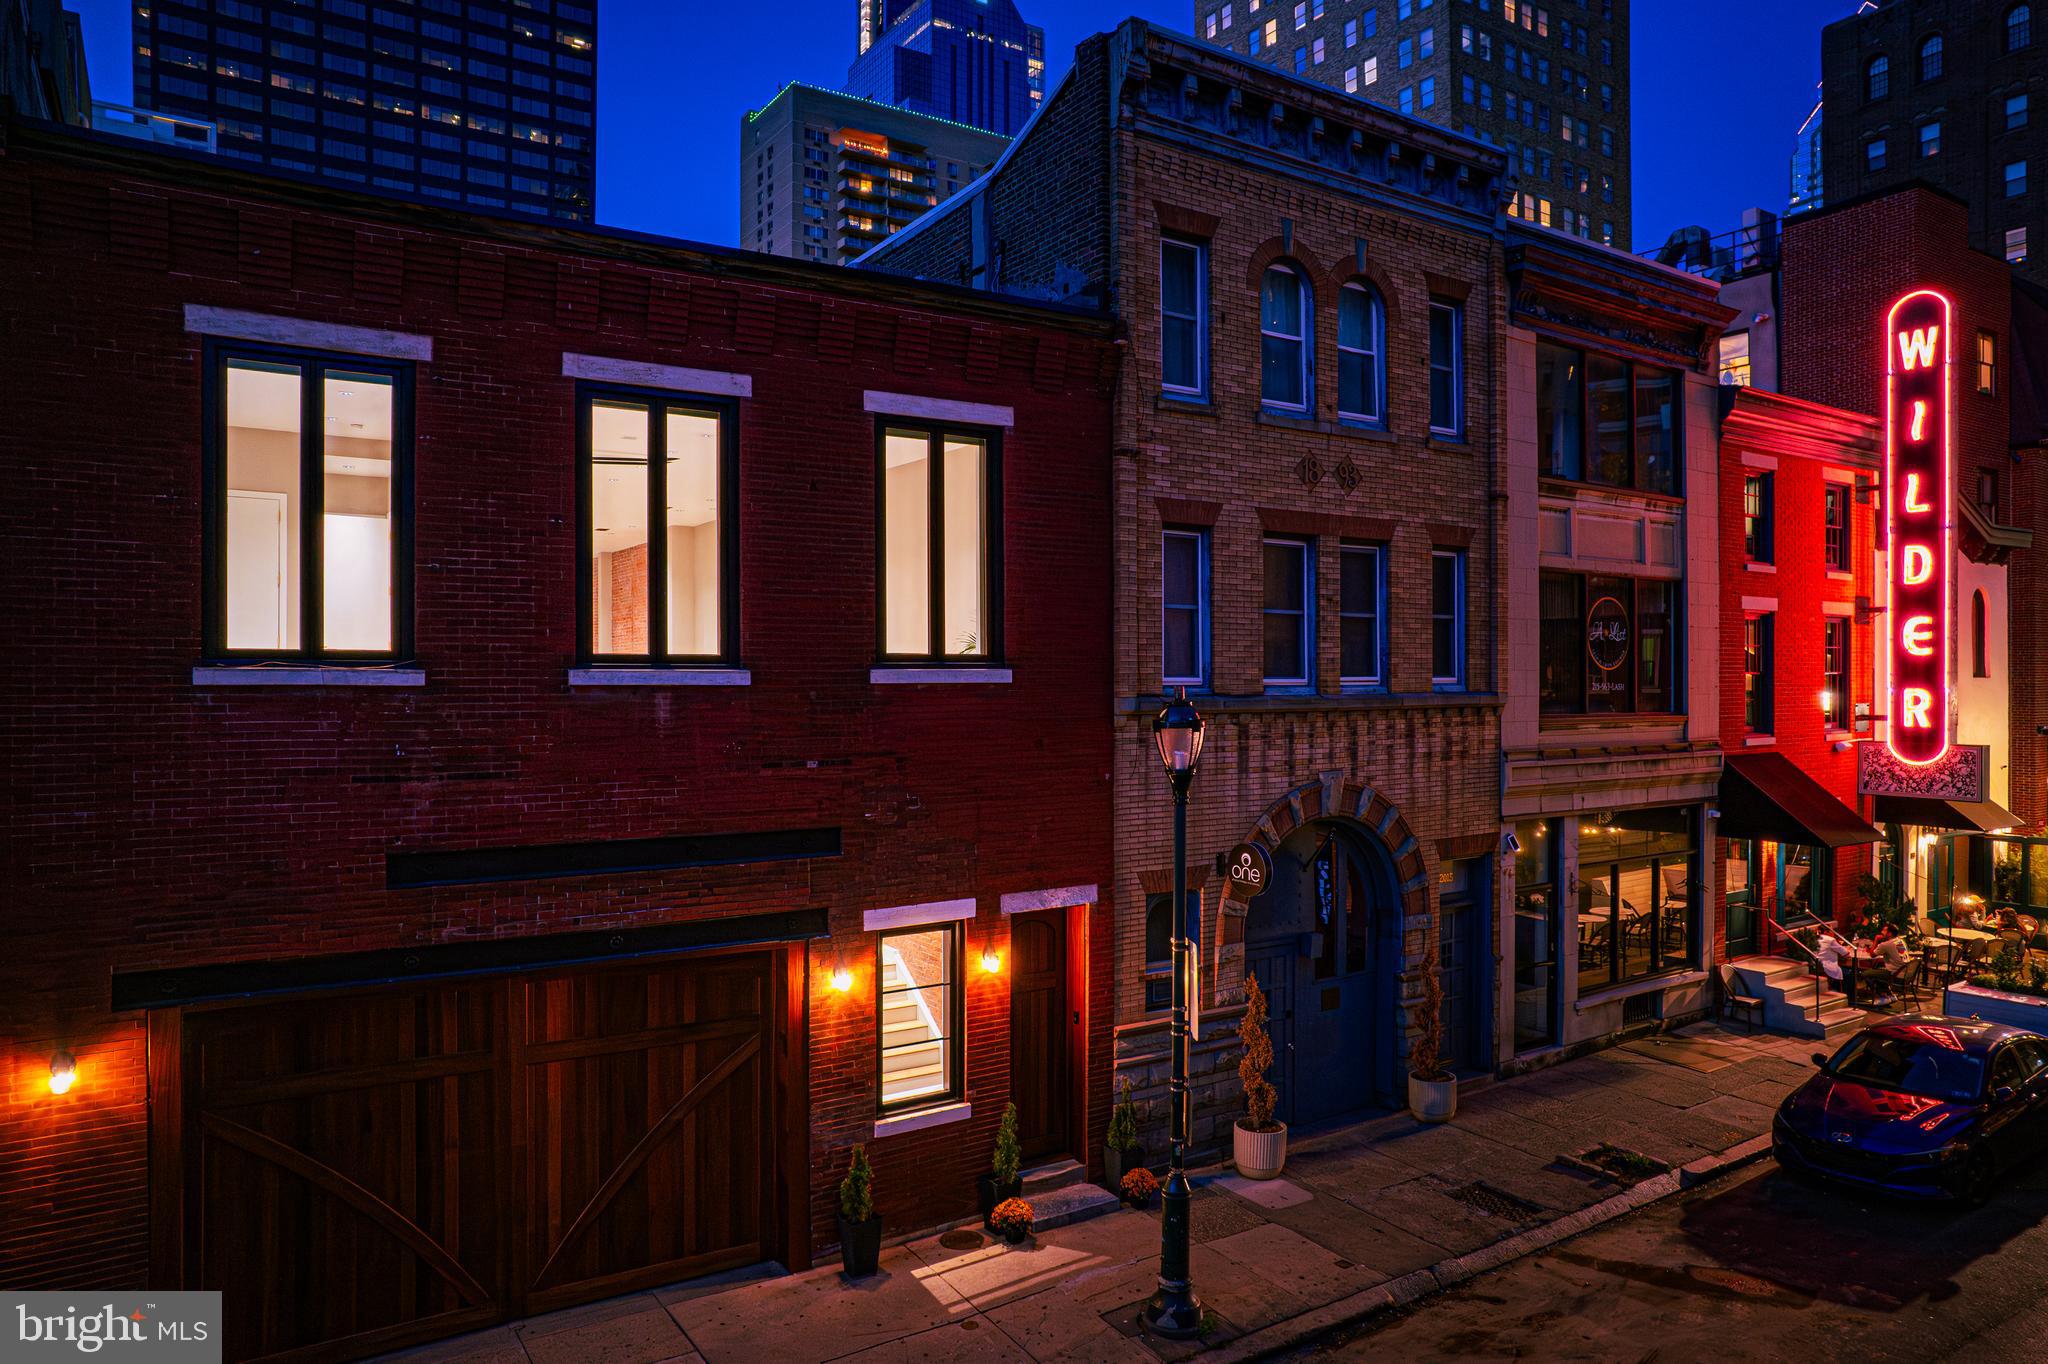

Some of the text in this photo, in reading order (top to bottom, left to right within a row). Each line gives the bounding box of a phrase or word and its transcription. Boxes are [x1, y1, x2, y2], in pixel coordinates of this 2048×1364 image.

[1305, 459, 1357, 488] 18 93
[1897, 324, 1940, 729] WILDER
[1232, 865, 1260, 882] one
